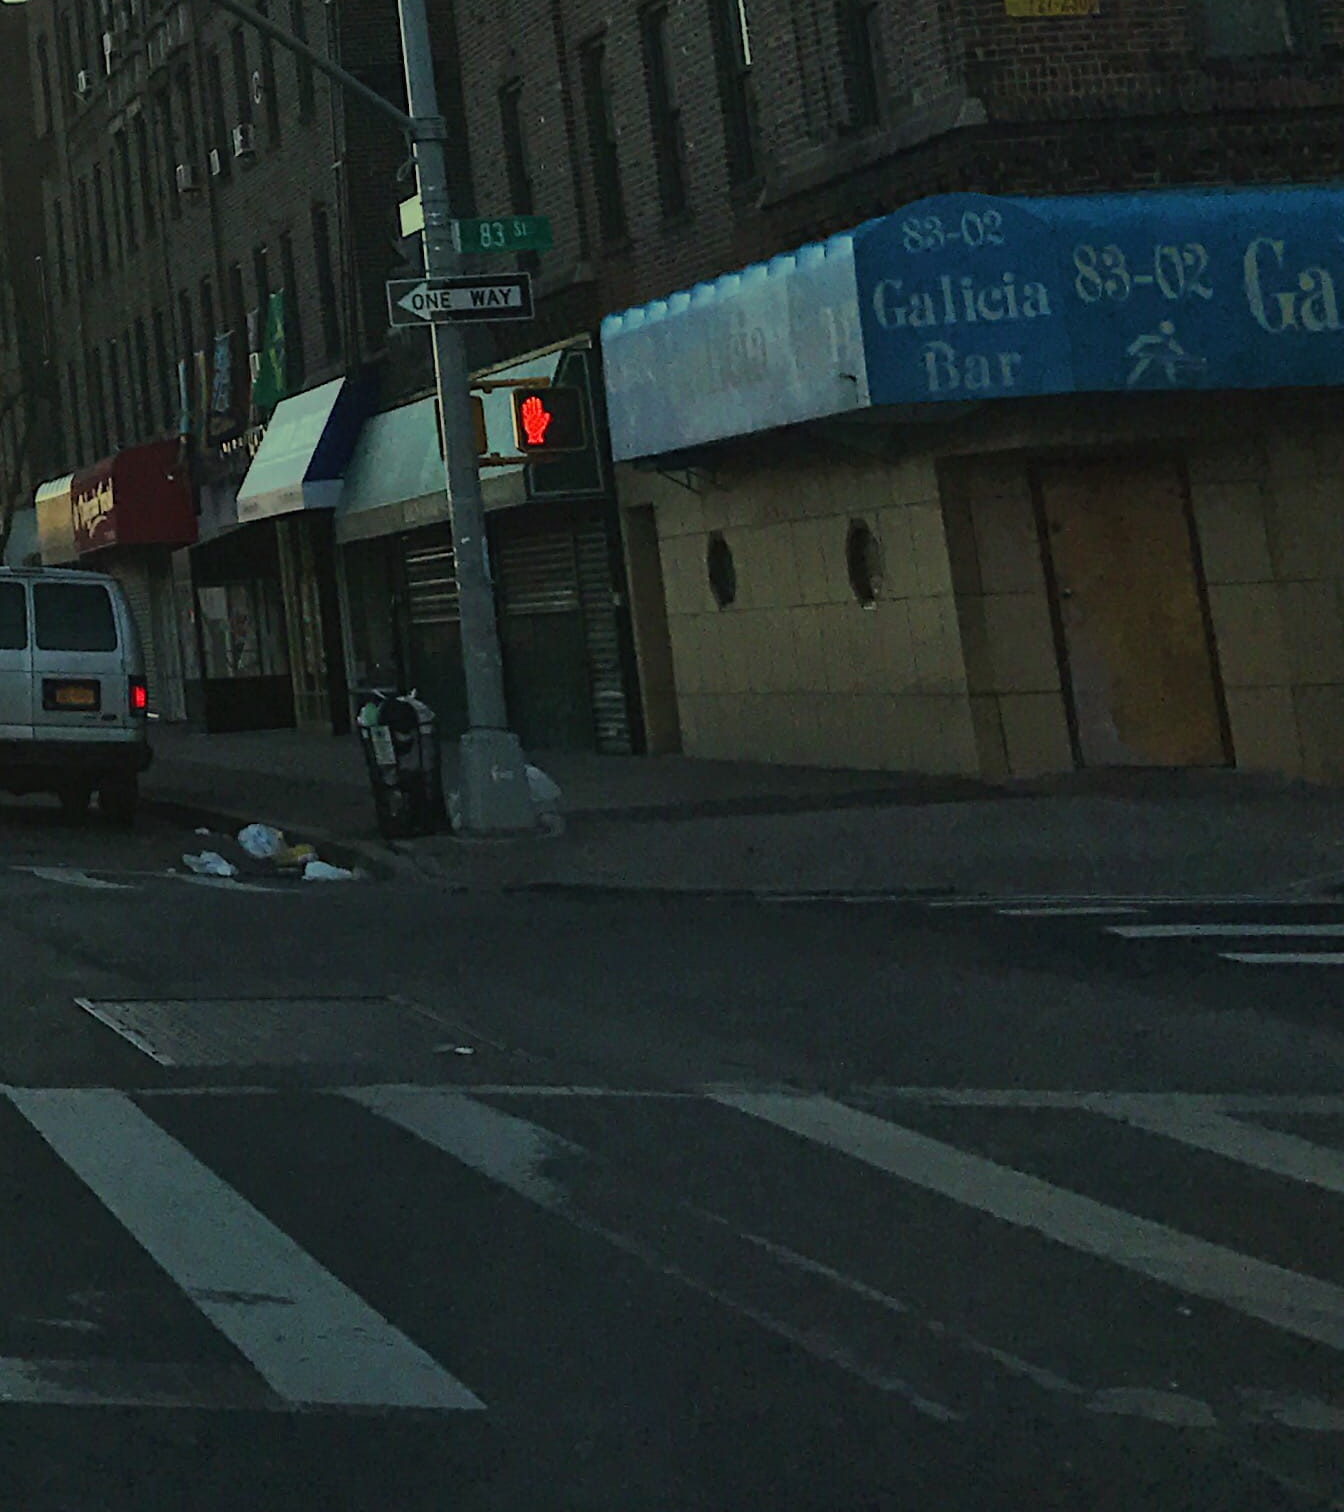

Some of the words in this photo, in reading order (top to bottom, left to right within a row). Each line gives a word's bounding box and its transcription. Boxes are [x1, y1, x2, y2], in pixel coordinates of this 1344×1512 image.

[479, 221, 506, 248] 83
[901, 207, 1009, 253] 83-02
[1073, 241, 1214, 304] 83-02
[412, 291, 451, 310] ONE
[470, 289, 511, 307] WAY
[871, 270, 1054, 330] Galicia
[919, 339, 1023, 393] Bar
